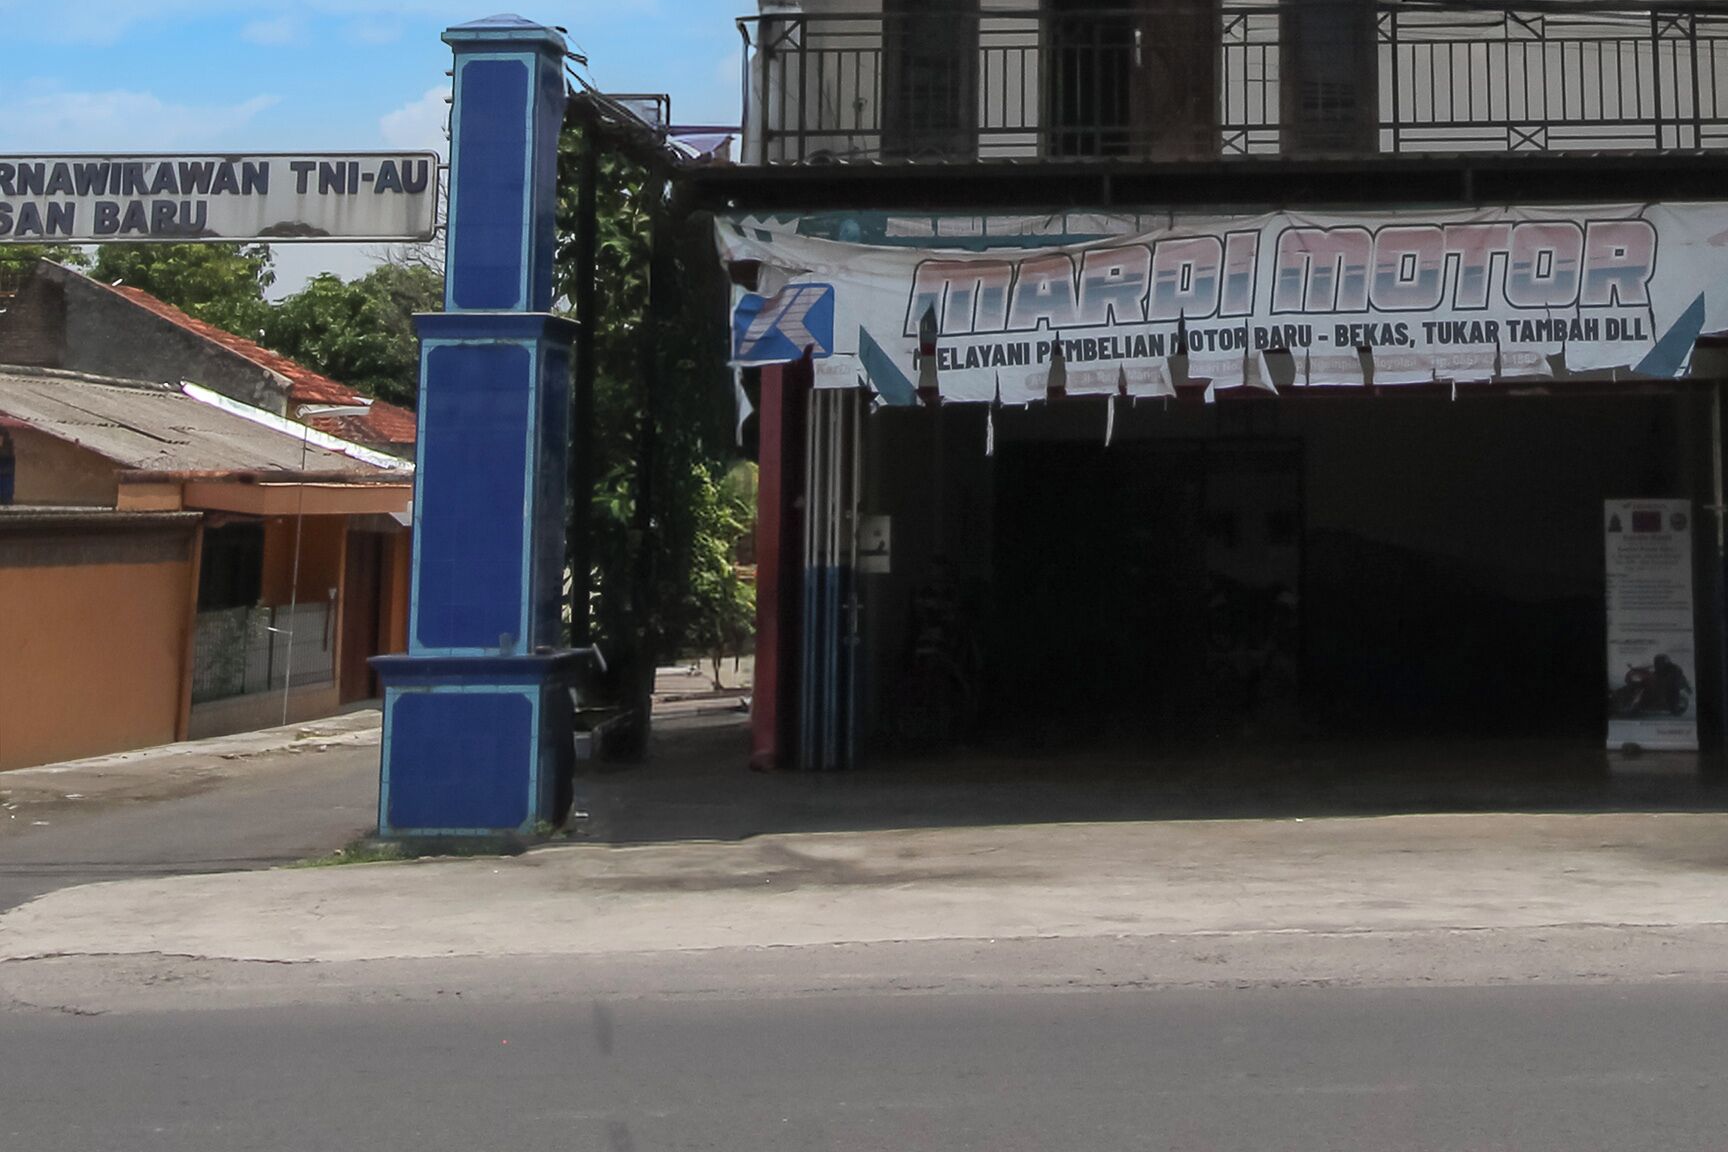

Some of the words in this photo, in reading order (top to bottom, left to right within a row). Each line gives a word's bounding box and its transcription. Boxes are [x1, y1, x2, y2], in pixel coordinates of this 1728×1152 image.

[291, 160, 428, 194] TNI-AU
[94, 199, 207, 235] BARU
[903, 229, 1261, 338] MARDI
[1271, 218, 1659, 316] MOTOR
[1254, 324, 1312, 350] BARU
[1334, 322, 1417, 349] BEKAS,
[1422, 320, 1499, 346] TUKAR
[1505, 318, 1599, 343] TAMBAH
[1605, 317, 1649, 342] DLL
